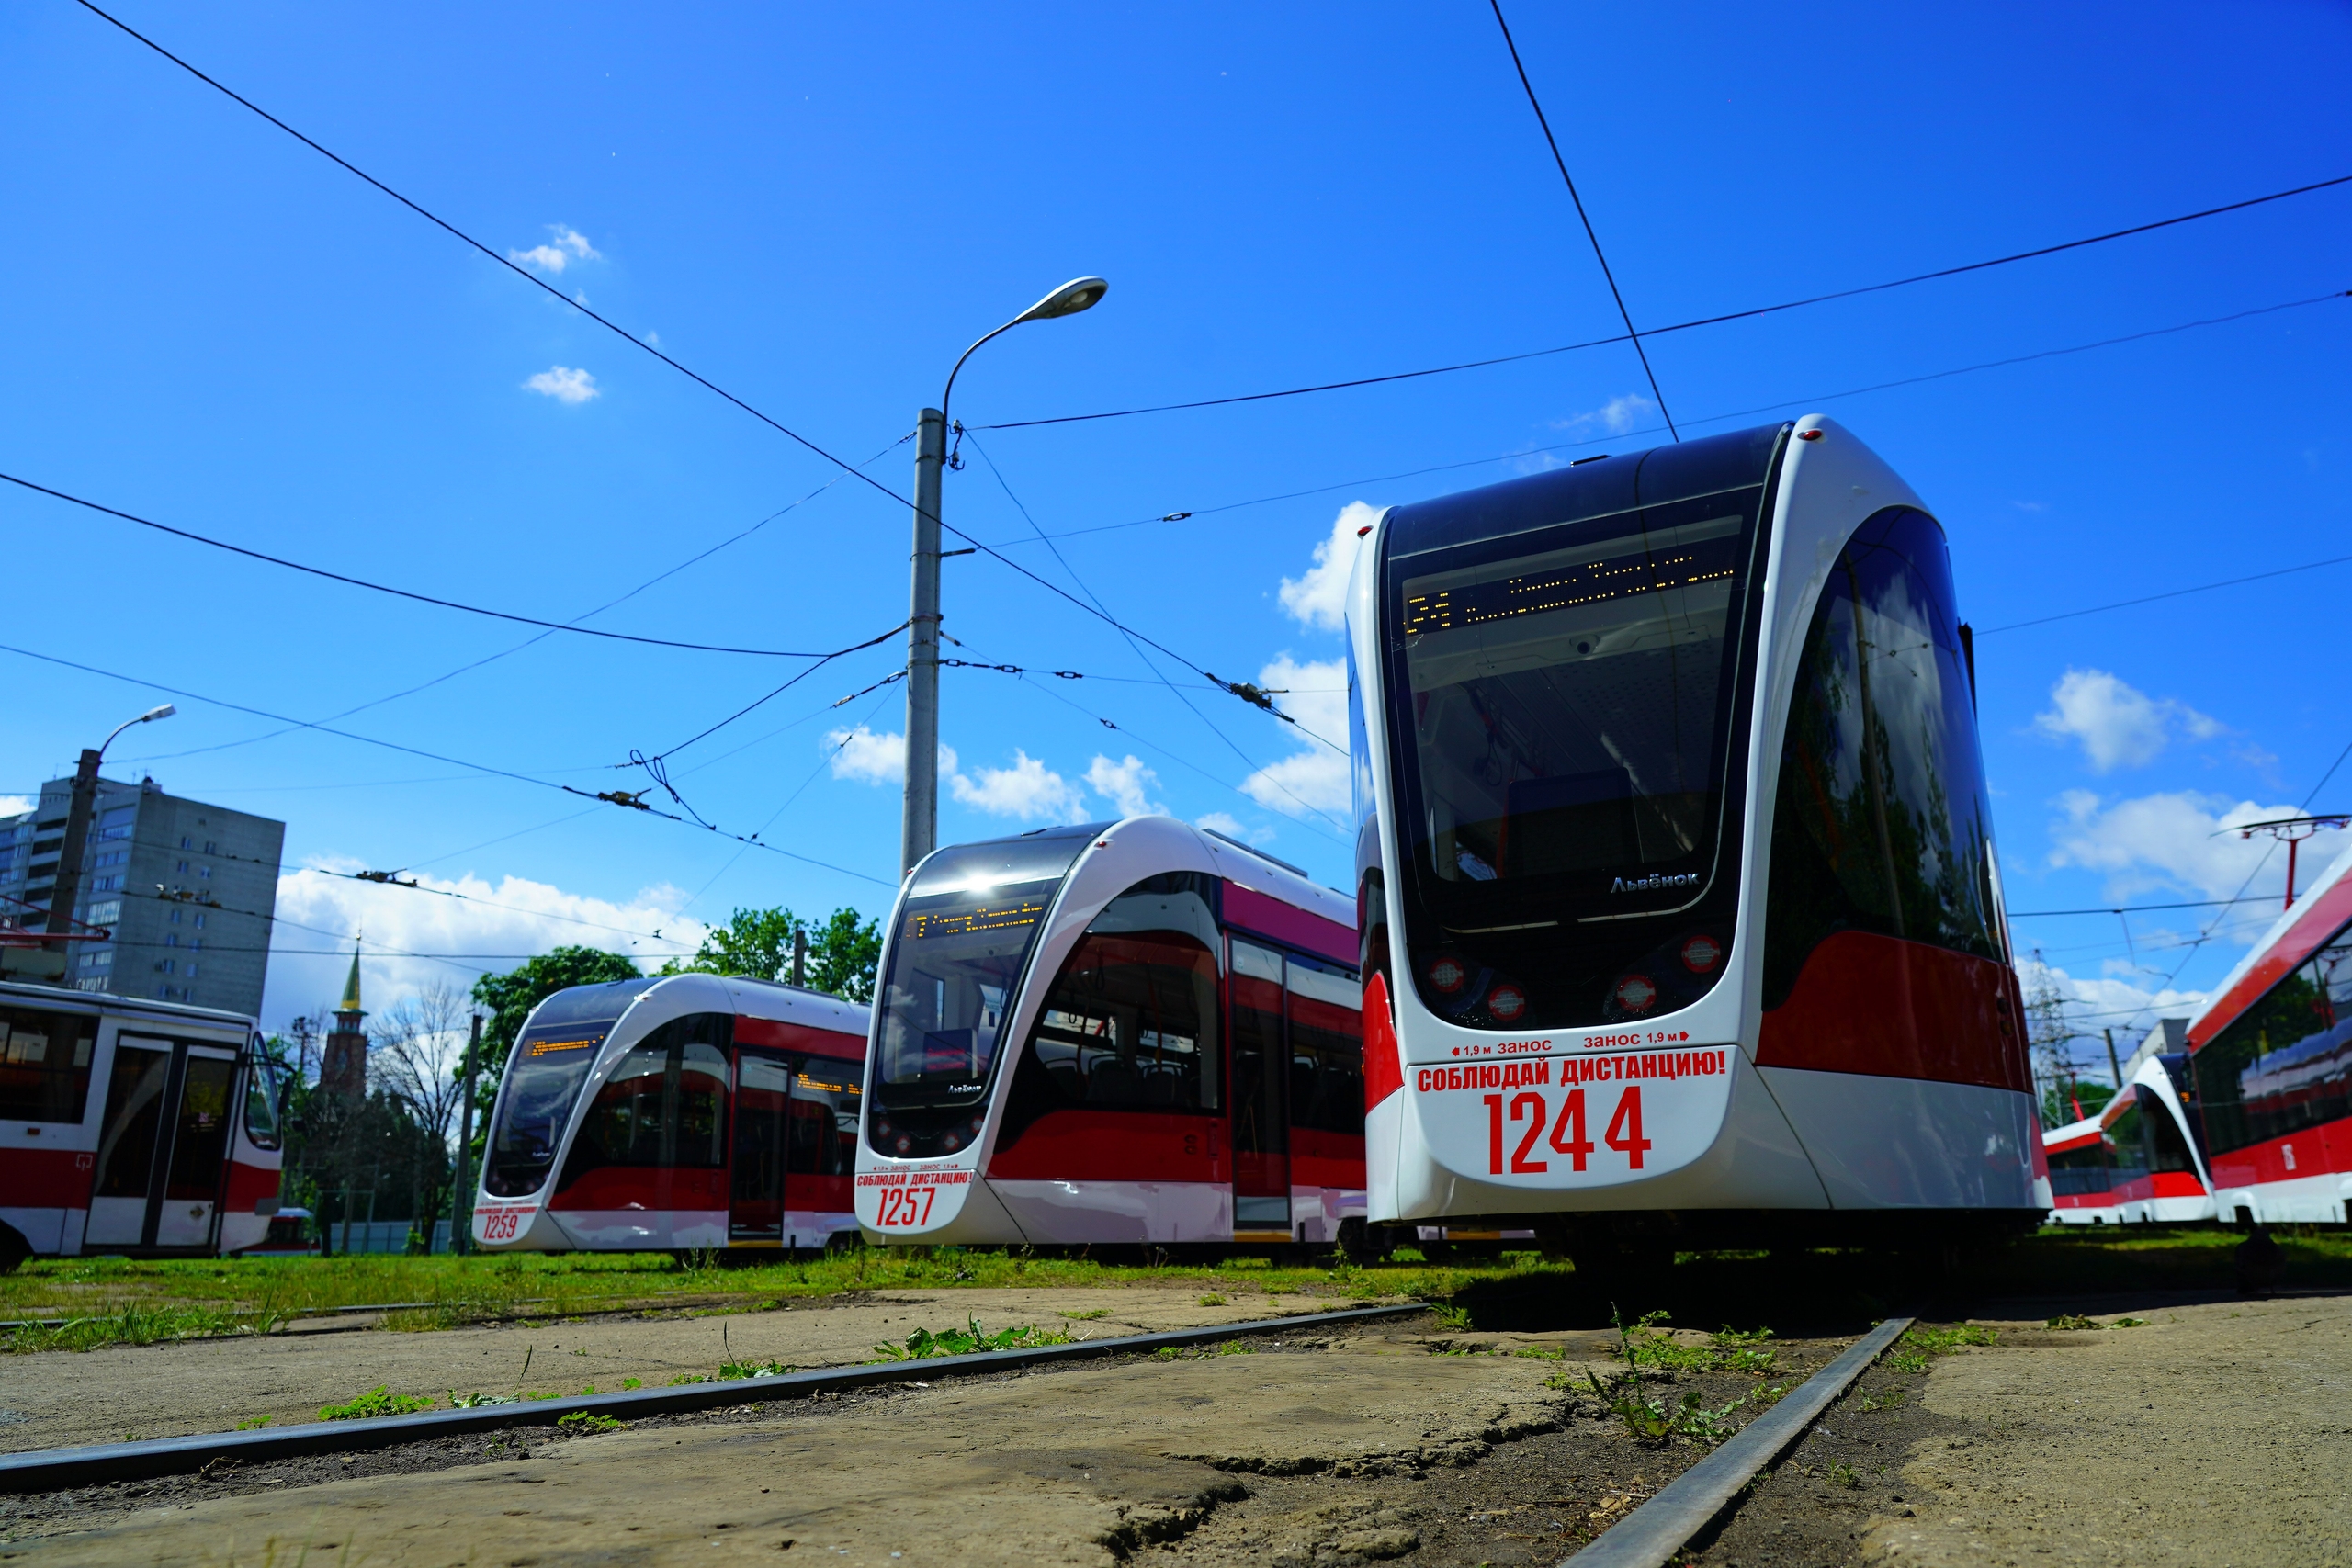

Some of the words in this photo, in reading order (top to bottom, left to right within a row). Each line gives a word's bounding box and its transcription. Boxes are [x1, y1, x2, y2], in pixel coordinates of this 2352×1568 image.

[1646, 1032, 1664, 1043] 1,9
[1464, 1045, 1480, 1057] 1,9
[1418, 1056, 1550, 1092] СОБЛЮДАЙ
[1560, 1050, 1726, 1088] ДИСТАНЦИЮ!
[1483, 1086, 1652, 1175] 1244
[856, 1172, 907, 1187] СОБЛЮДАЙ
[910, 1171, 973, 1186] ДИСТАНЦИЮ!
[876, 1187, 936, 1226] 1257
[483, 1214, 518, 1239] 1259
